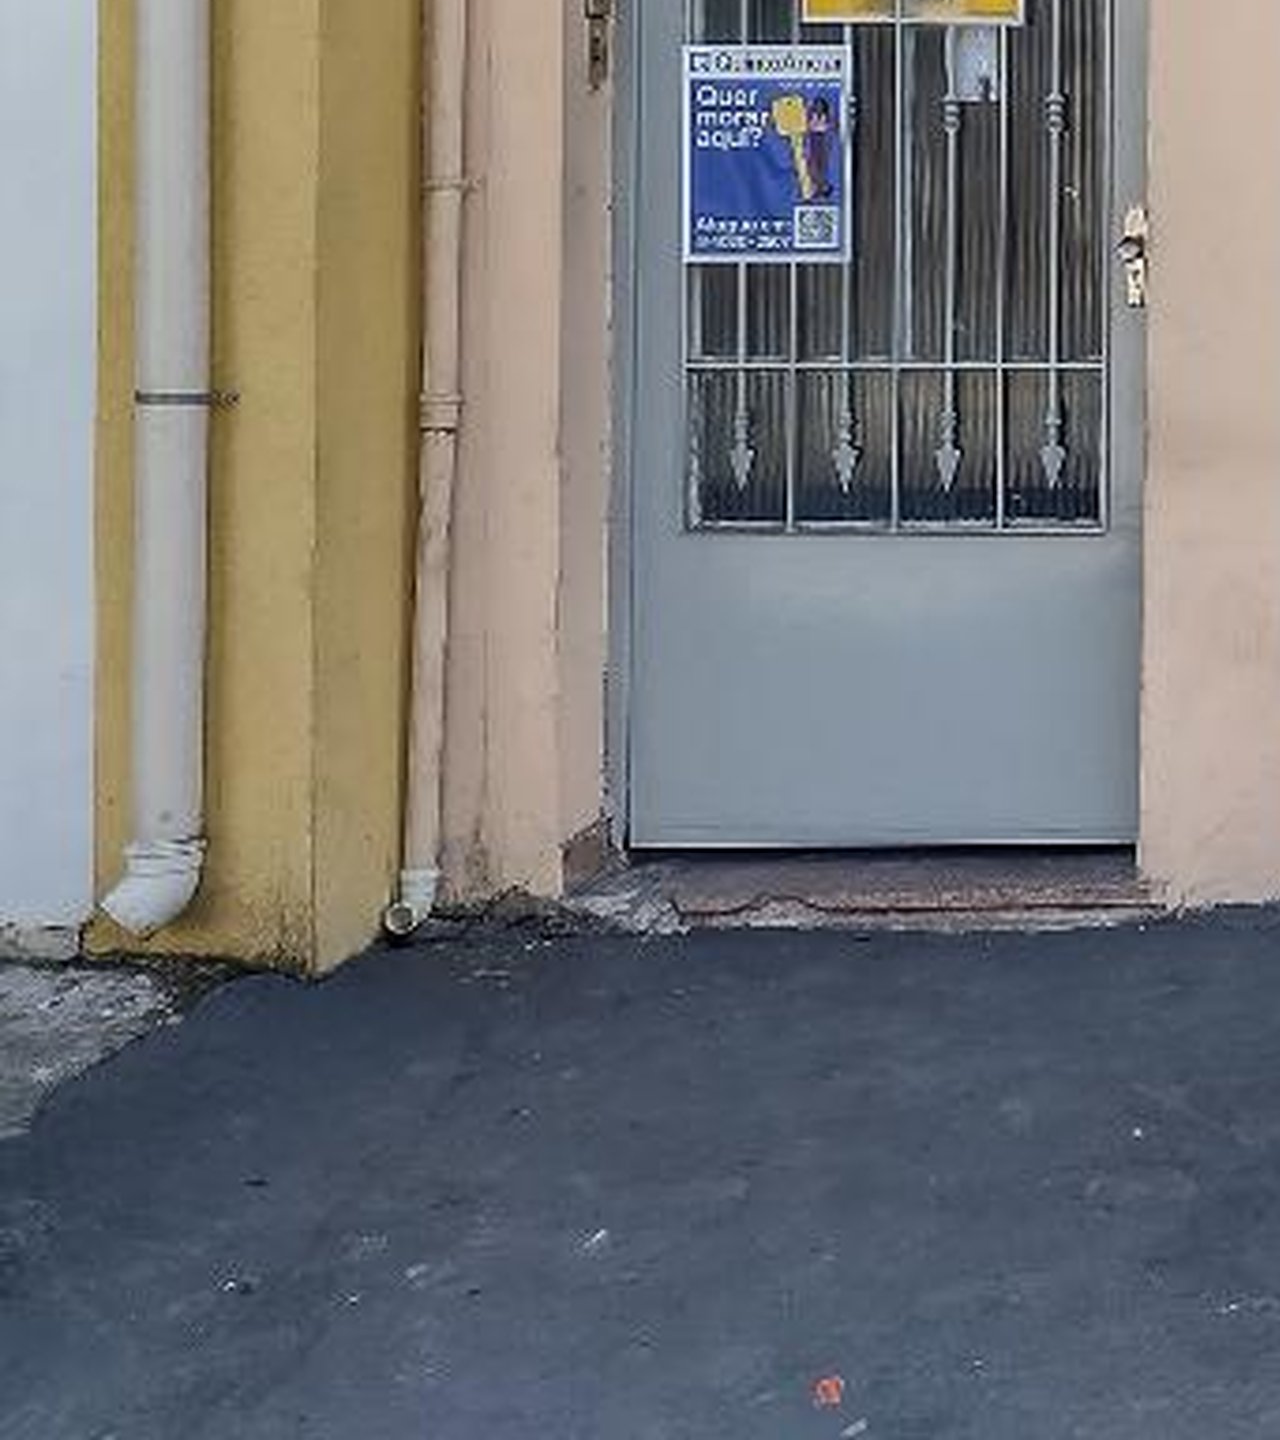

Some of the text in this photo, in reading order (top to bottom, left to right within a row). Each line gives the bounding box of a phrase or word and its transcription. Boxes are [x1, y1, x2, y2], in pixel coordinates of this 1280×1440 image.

[697, 85, 759, 106] Quer
[696, 111, 769, 127] morar
[696, 127, 763, 149] aqui?
